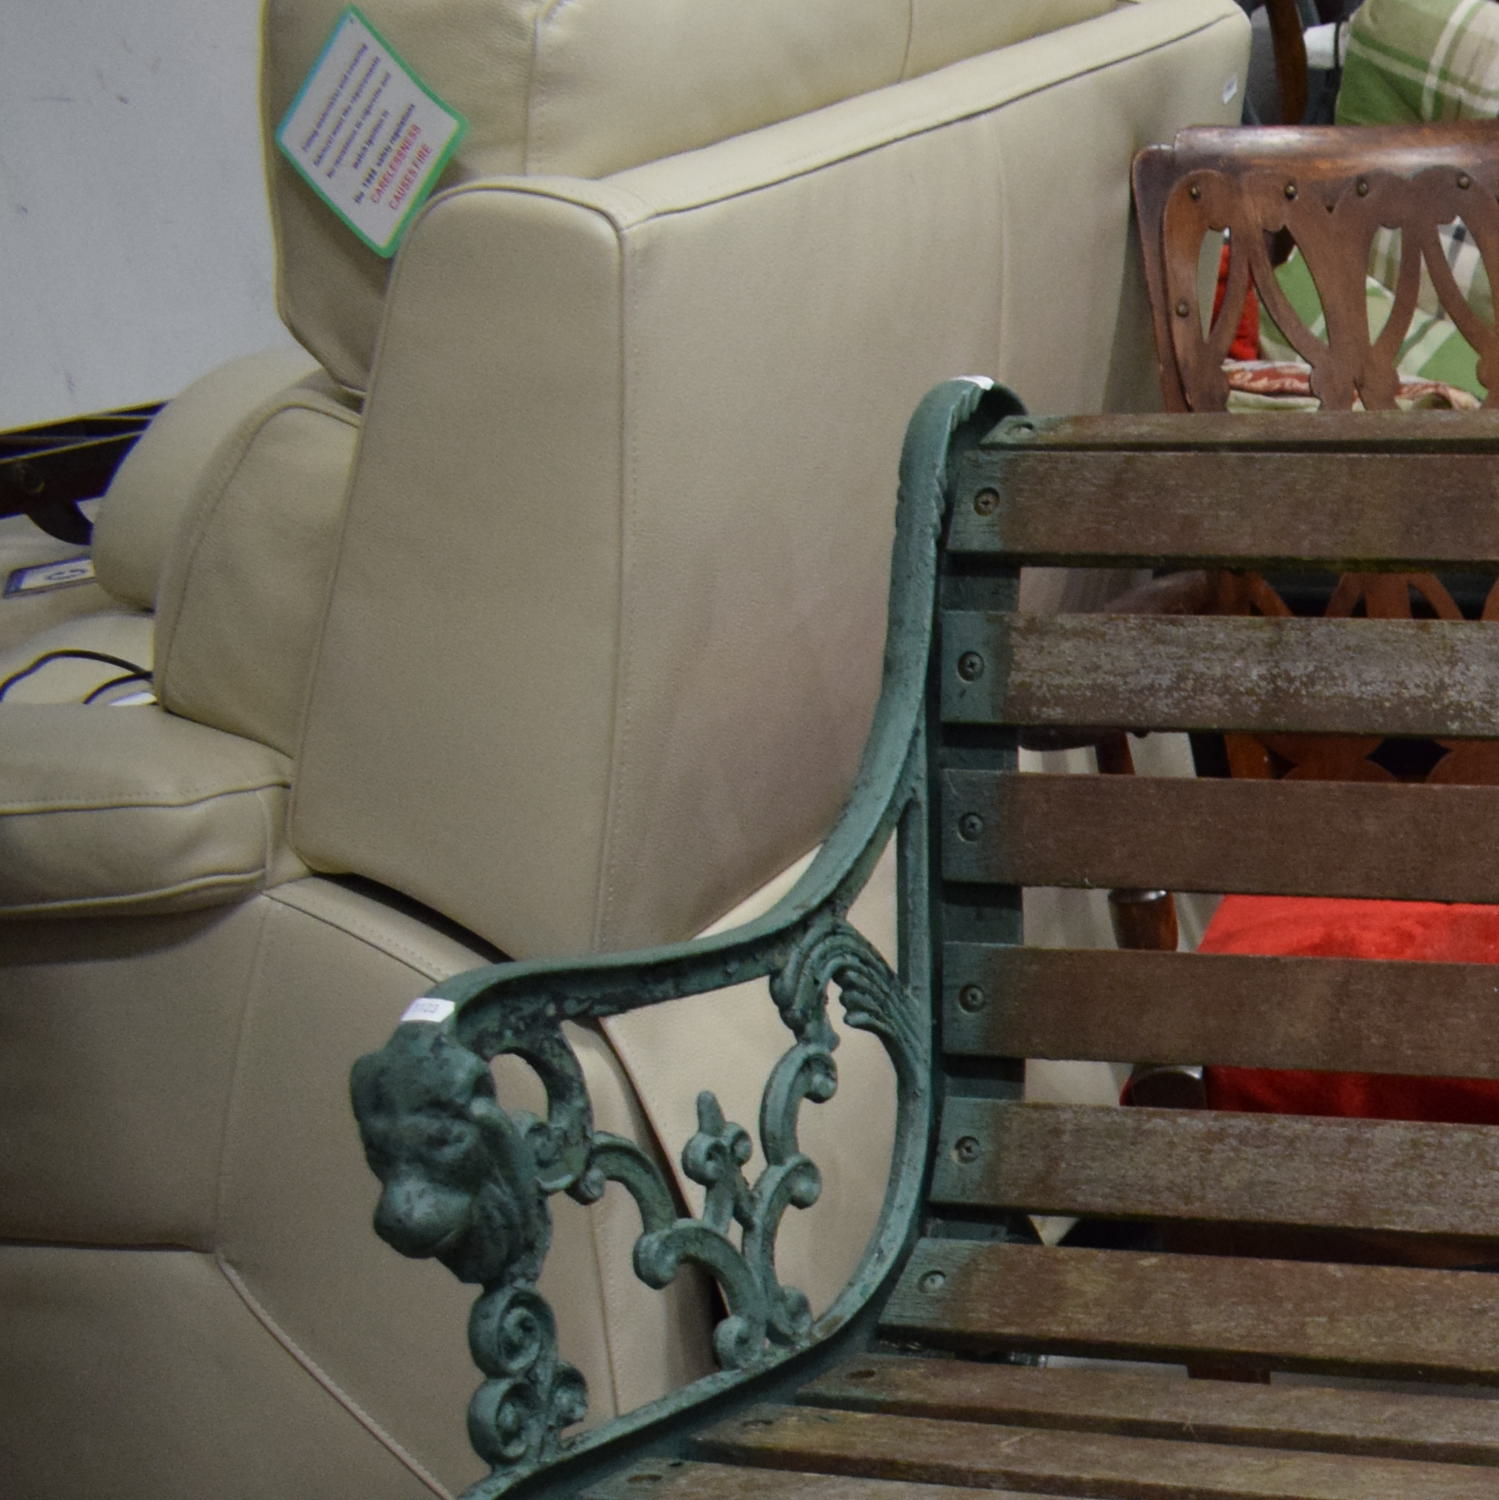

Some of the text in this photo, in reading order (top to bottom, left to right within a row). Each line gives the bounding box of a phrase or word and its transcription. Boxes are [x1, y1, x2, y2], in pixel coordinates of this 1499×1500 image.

[369, 122, 422, 206] CARELESSNESS
[373, 141, 393, 169] safety
[386, 100, 417, 146] regulations
[386, 141, 433, 213] CAUSES FIRE
